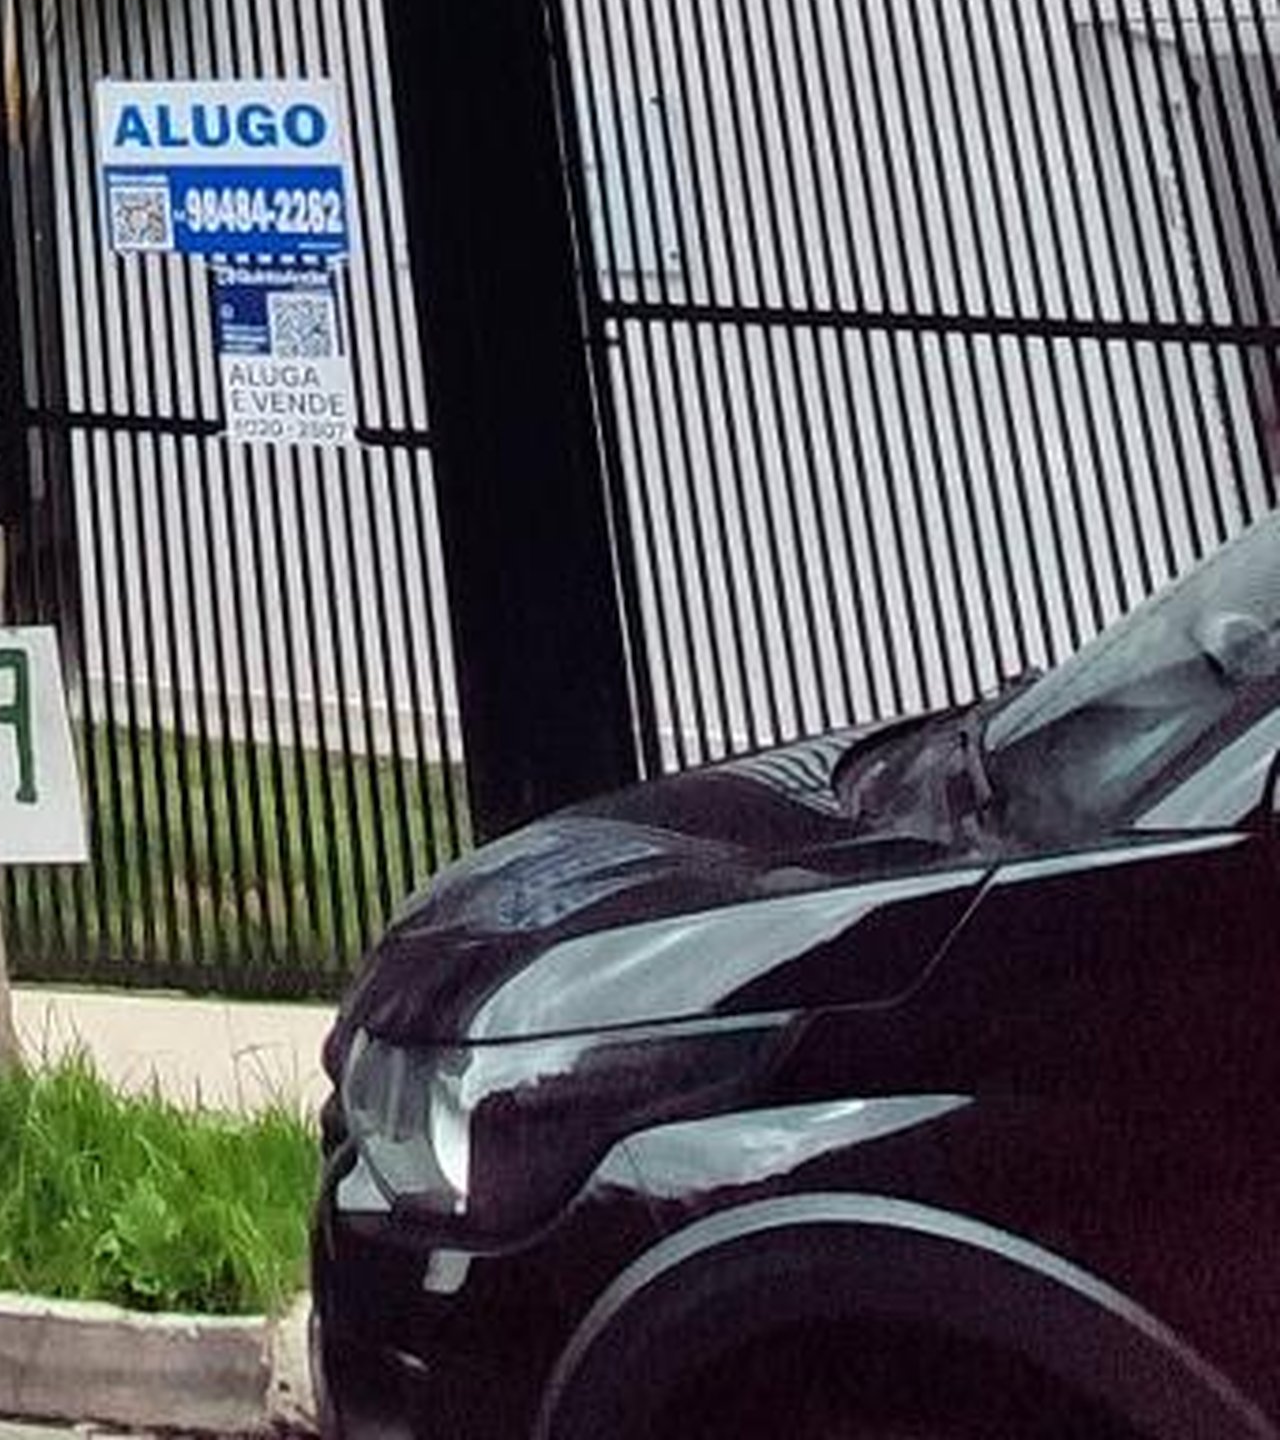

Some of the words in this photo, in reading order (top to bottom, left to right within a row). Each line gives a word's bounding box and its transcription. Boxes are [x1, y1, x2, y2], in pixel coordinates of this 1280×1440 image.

[114, 103, 327, 148] ALUGO
[229, 364, 321, 388] ALUGA
[251, 391, 347, 417] VENDE
